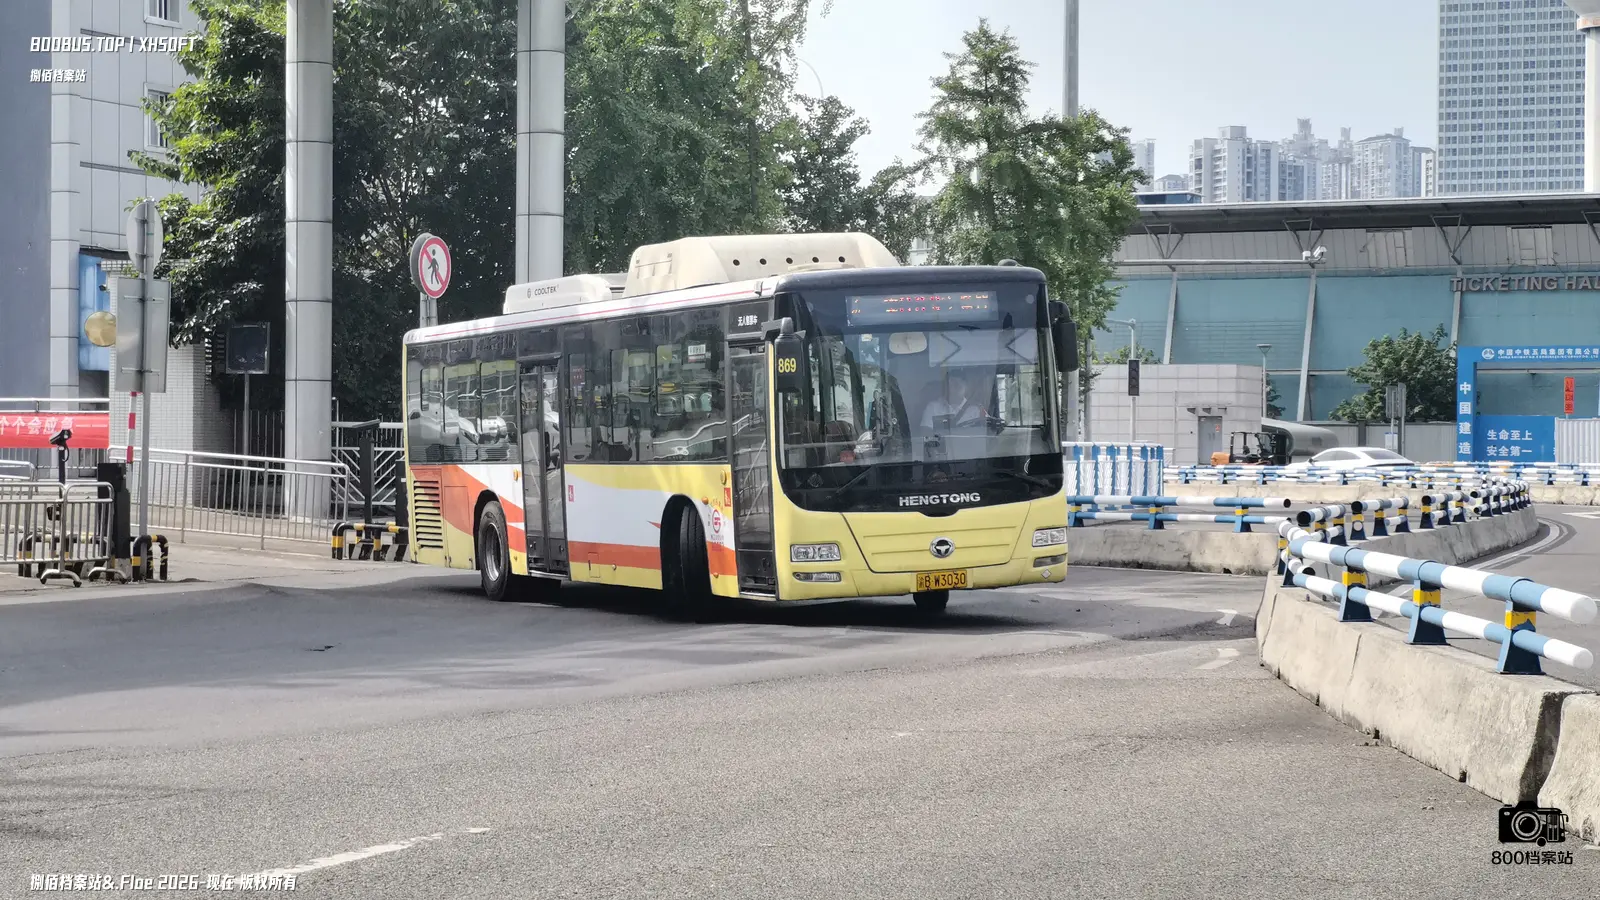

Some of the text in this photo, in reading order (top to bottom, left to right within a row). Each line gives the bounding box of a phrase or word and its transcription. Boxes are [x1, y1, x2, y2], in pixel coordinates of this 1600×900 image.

[1450, 276, 1558, 291] TICKETING
[778, 357, 797, 373] 869
[1458, 381, 1472, 454] 中国建造
[1487, 429, 1533, 441] 生命至上
[1486, 446, 1533, 457] 安全第一
[899, 492, 980, 507] HENGTONG
